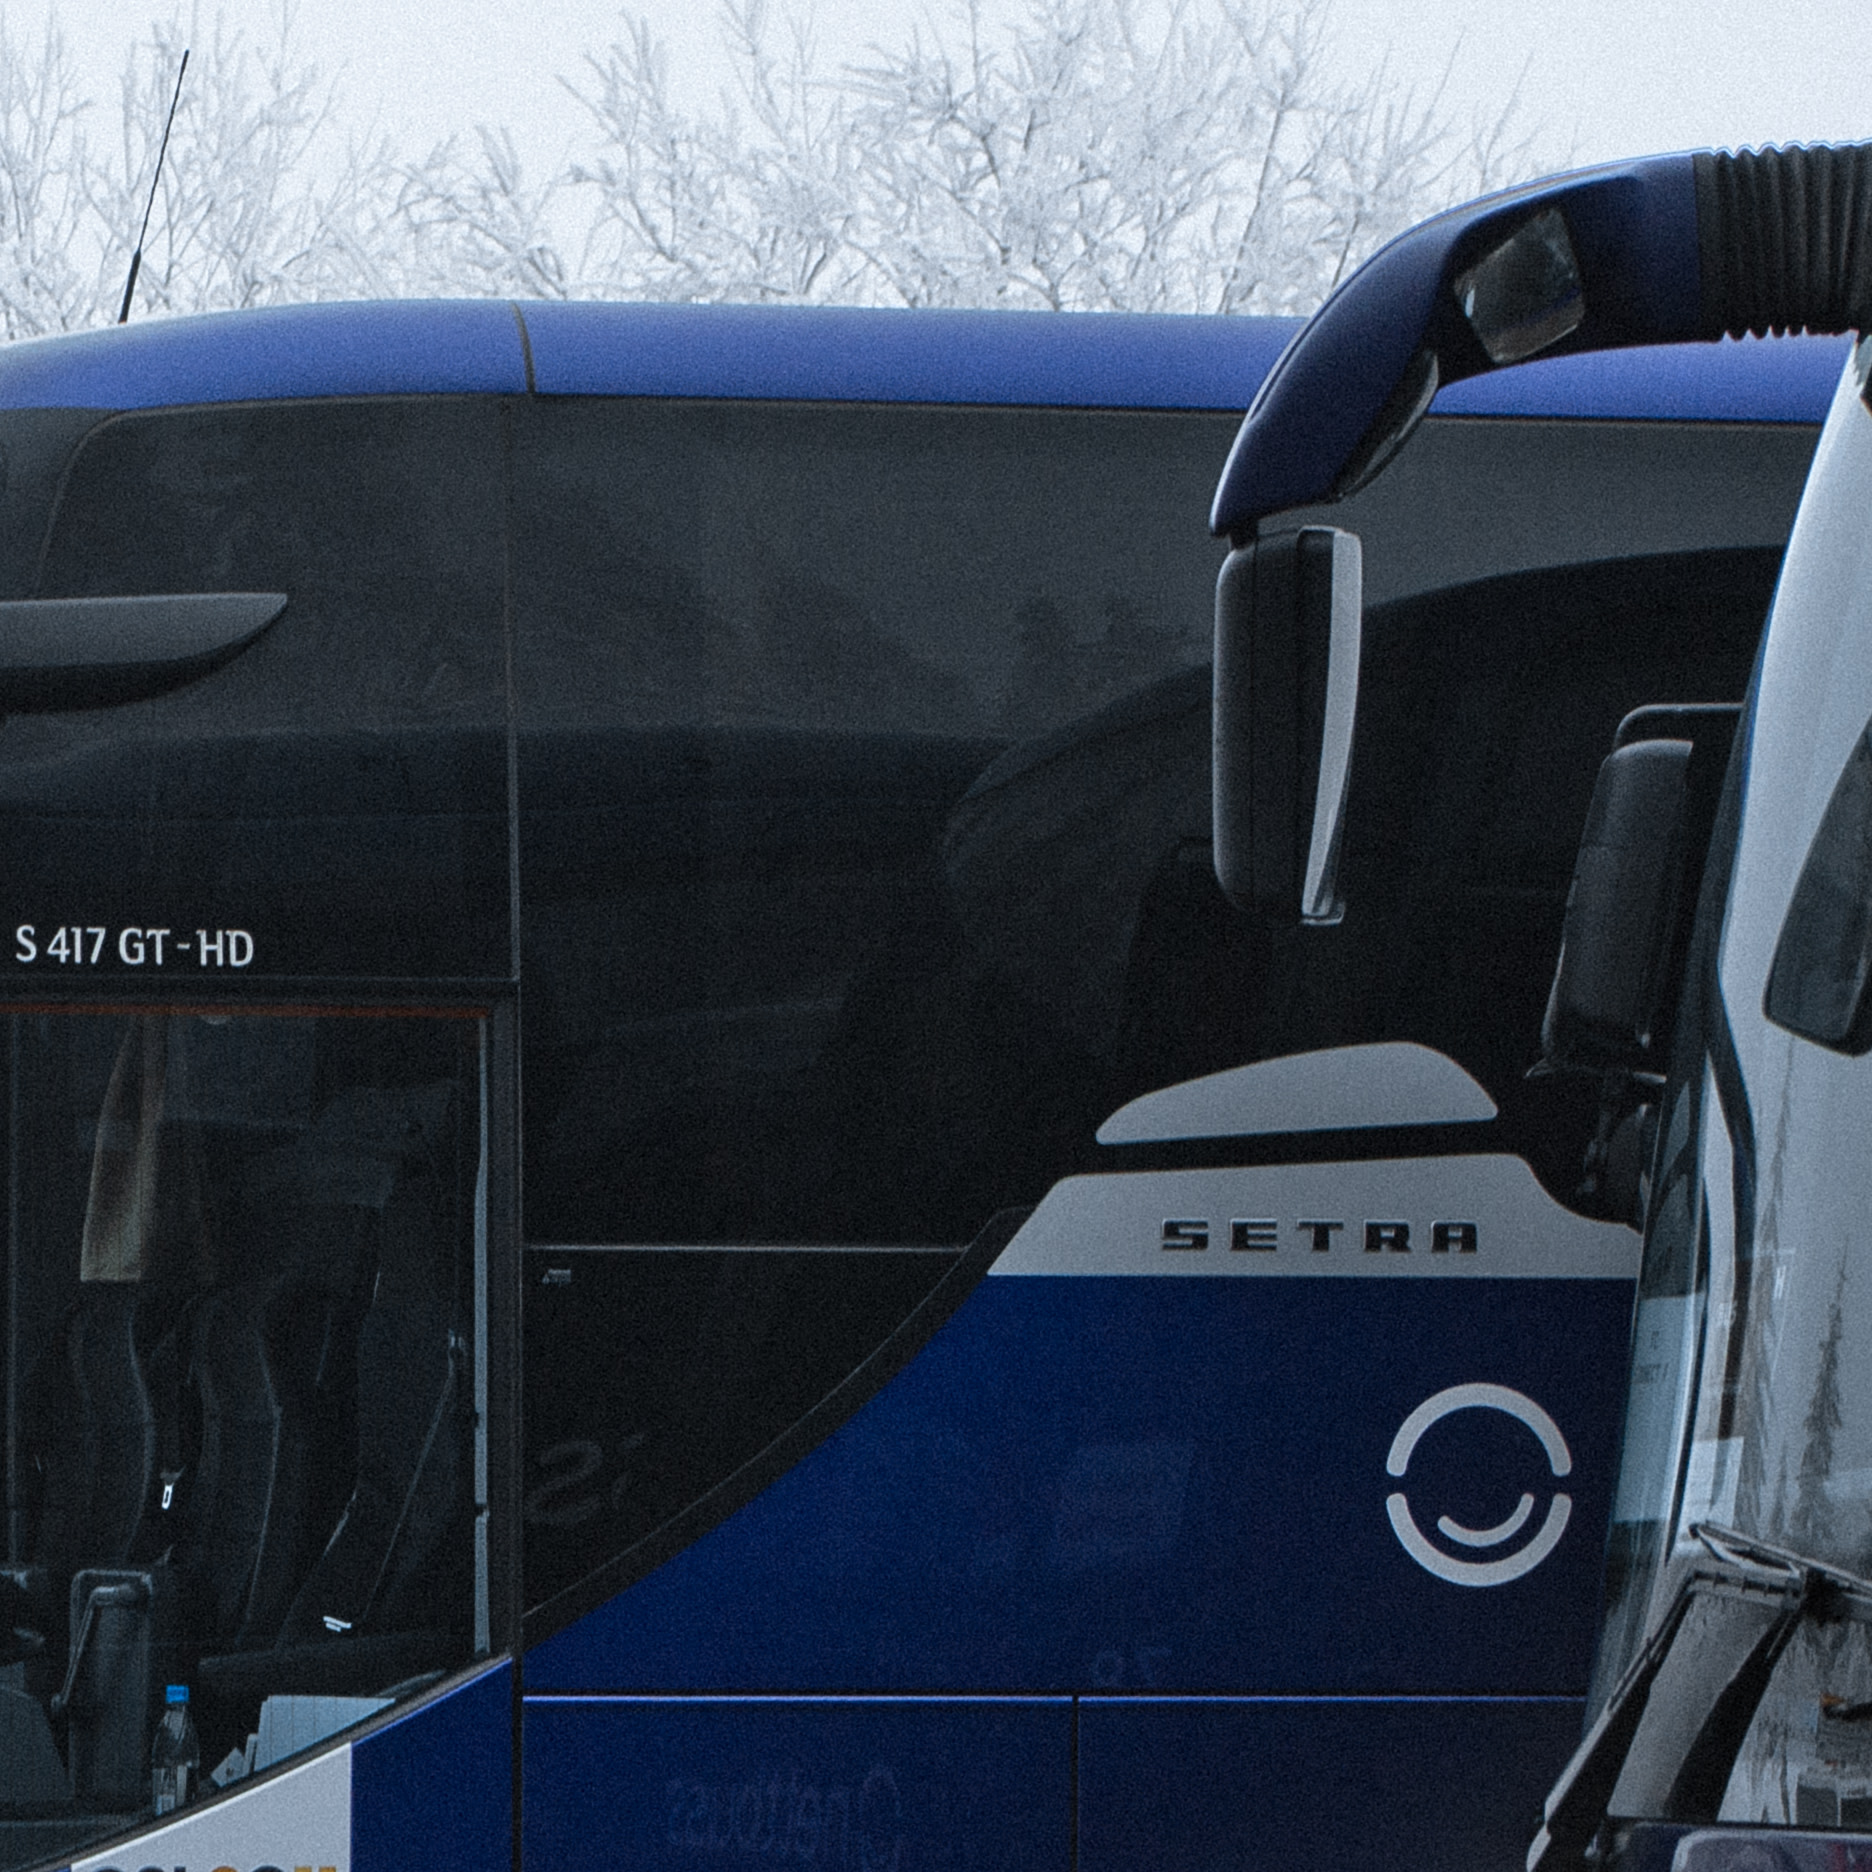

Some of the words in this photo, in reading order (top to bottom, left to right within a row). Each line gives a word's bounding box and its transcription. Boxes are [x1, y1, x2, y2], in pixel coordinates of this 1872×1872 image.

[16, 924, 37, 963] S
[47, 926, 105, 963] 417
[1161, 1218, 1478, 1253] SETRA
